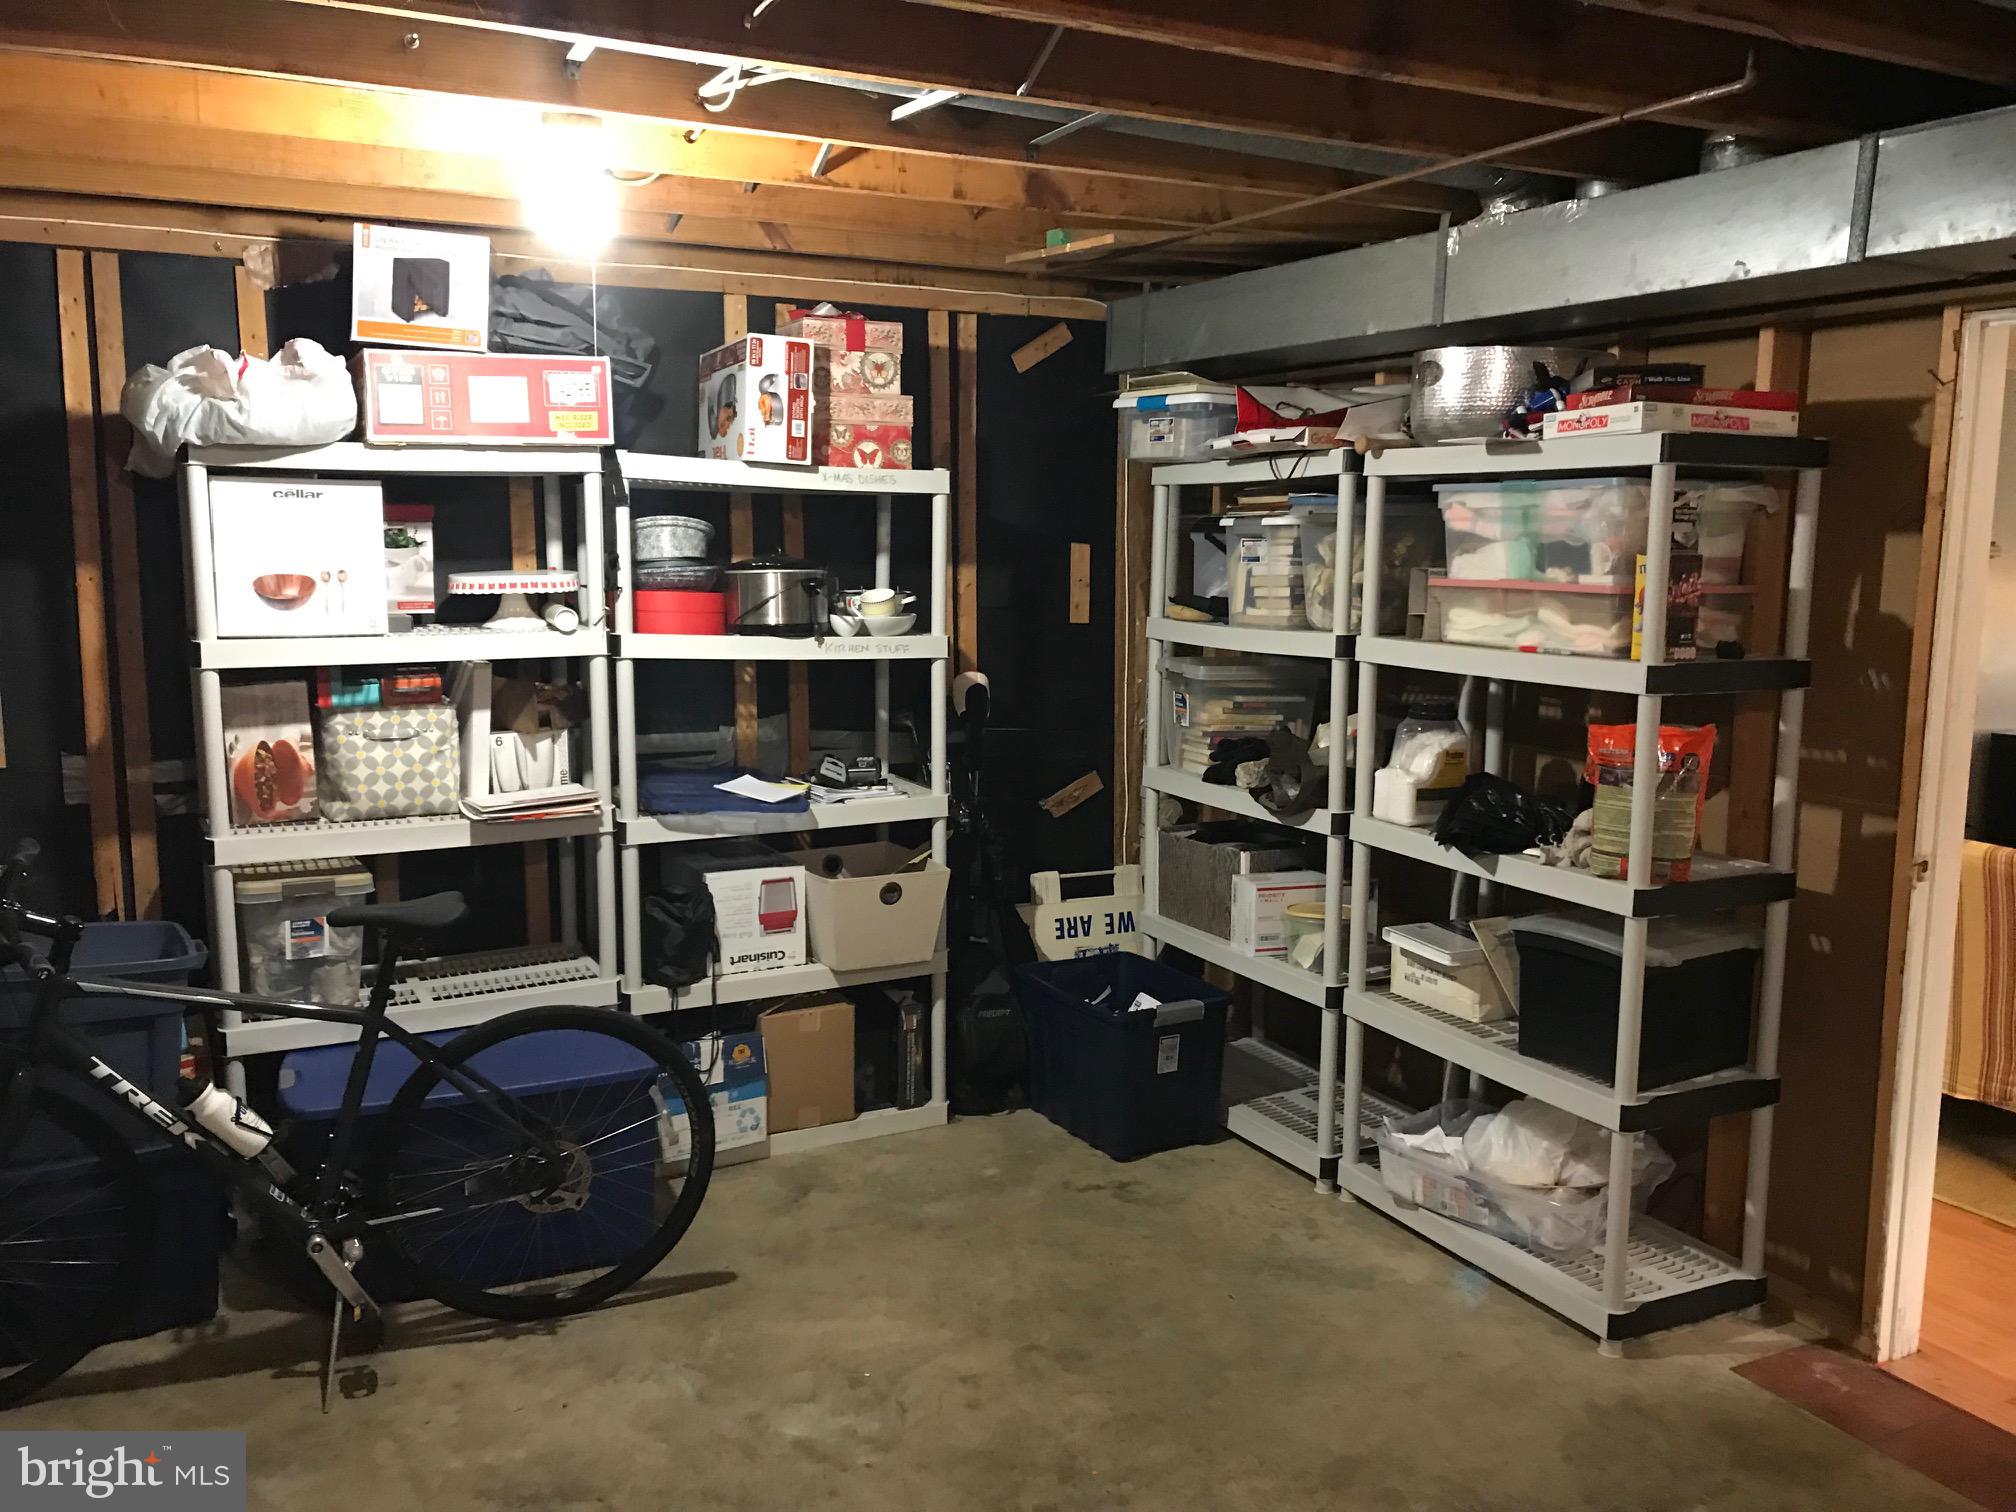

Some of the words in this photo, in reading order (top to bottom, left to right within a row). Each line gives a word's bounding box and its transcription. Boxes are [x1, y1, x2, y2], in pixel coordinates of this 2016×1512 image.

[1558, 416, 1608, 432] MONOPOLY
[1691, 414, 1749, 430] MONOPOLY
[857, 473, 897, 485] DISHES
[272, 489, 323, 499] cellar
[874, 643, 910, 655] STUFF
[495, 736, 504, 747] 6
[1054, 914, 1093, 940] ARE
[1104, 911, 1136, 935] WE
[729, 950, 786, 966] Cuisinart
[89, 1055, 208, 1150] TREK
